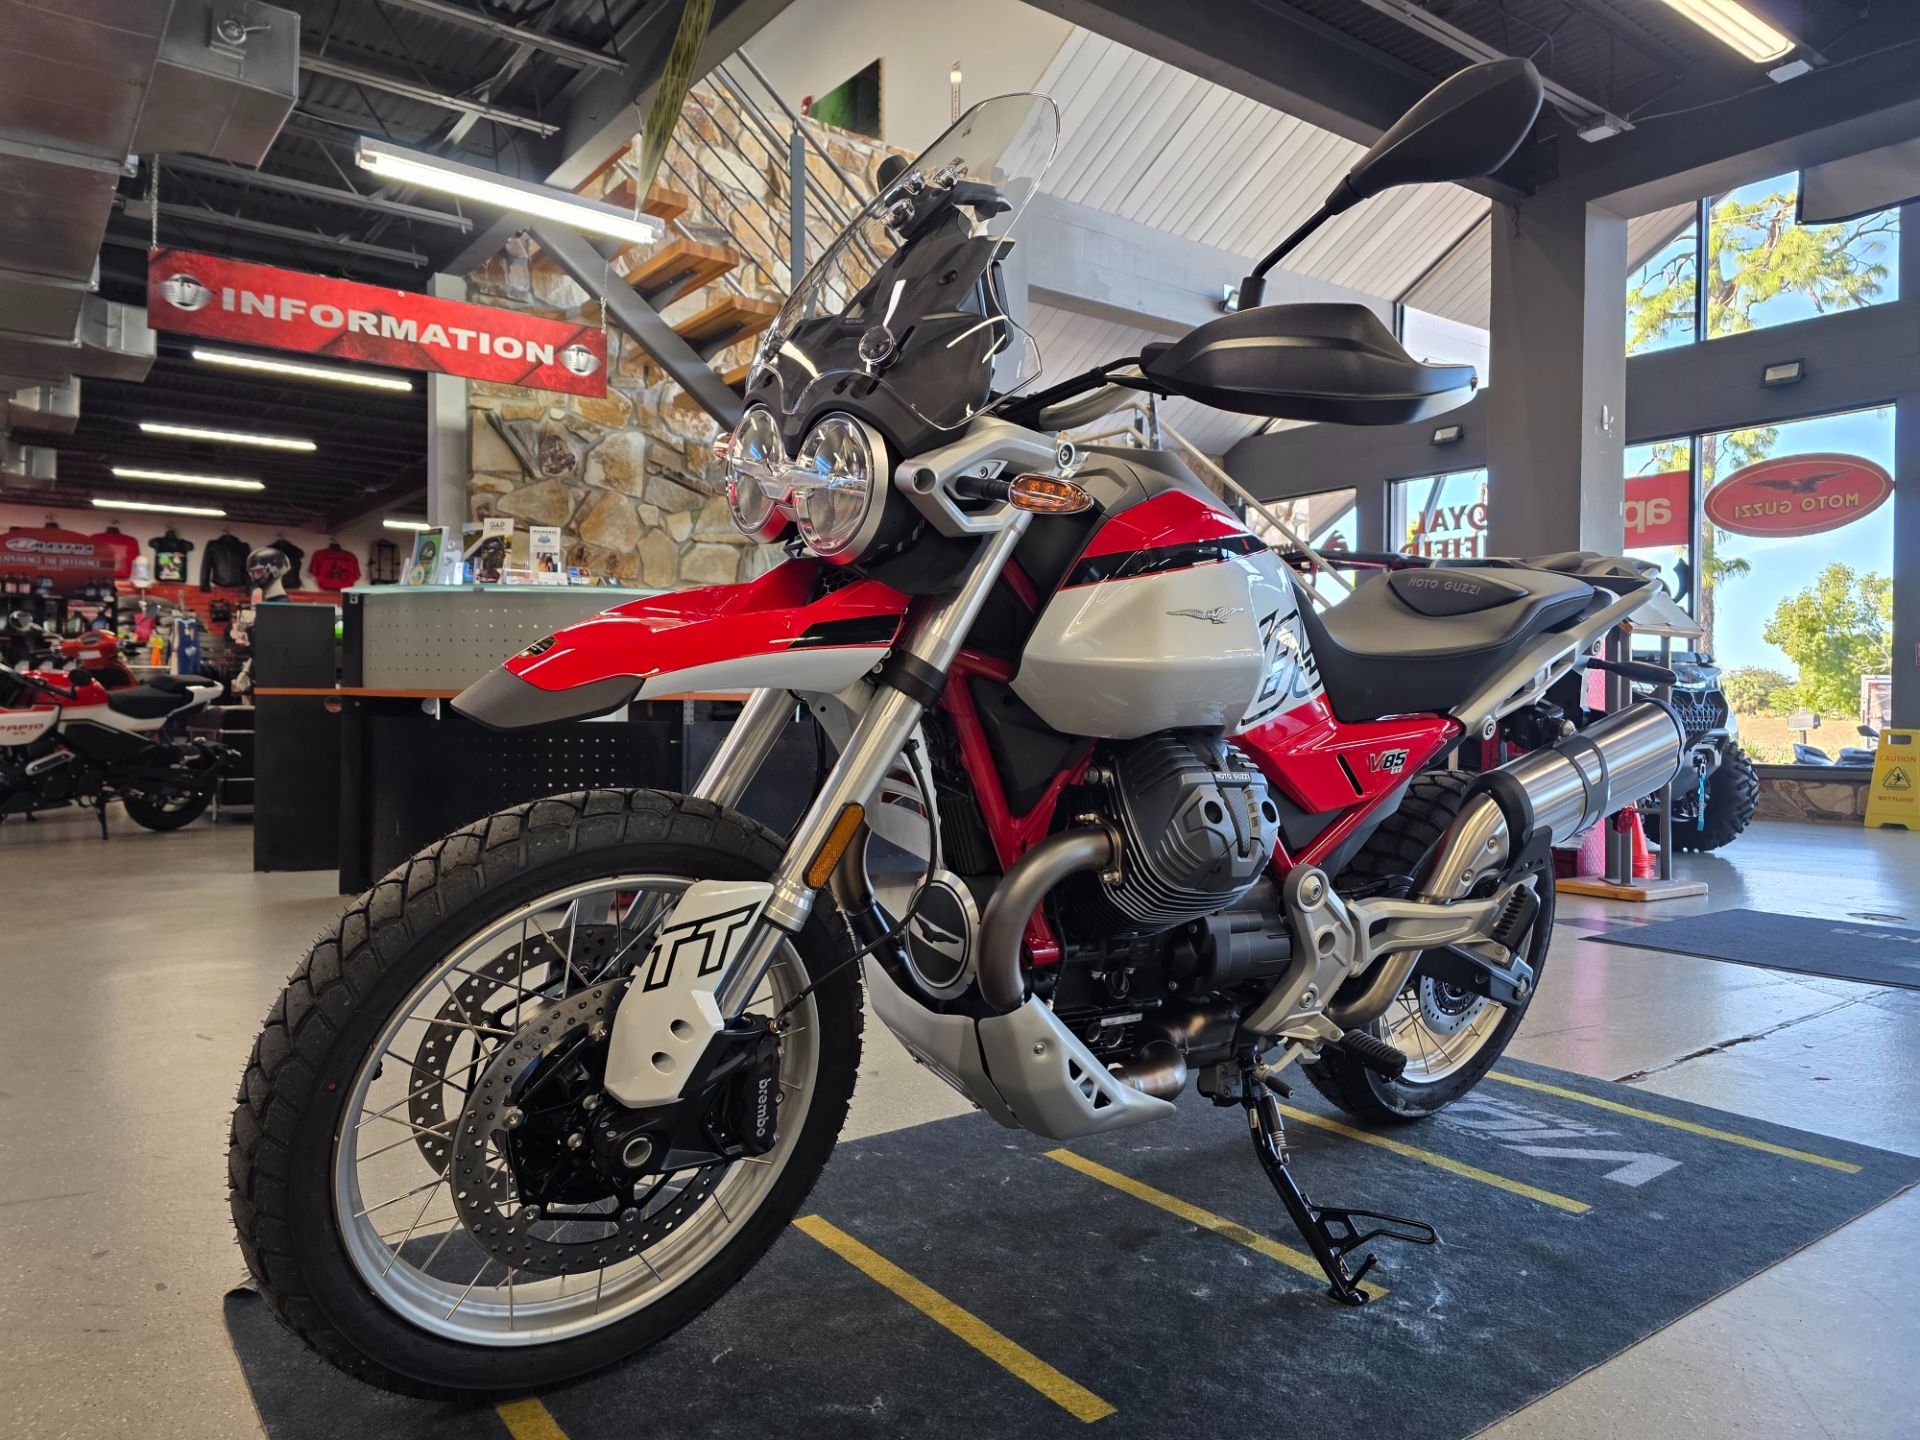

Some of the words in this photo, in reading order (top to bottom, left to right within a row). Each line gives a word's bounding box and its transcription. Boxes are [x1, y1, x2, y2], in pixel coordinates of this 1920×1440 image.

[221, 287, 554, 366] INFORMATION
[1408, 576, 1439, 590] MOTO
[1444, 581, 1481, 597] GUZZI
[1368, 748, 1410, 773] V85
[1879, 754, 1917, 763] CAUTION
[1214, 772, 1231, 781] MOTO
[642, 900, 762, 993] TT
[756, 1077, 772, 1138] brembo
